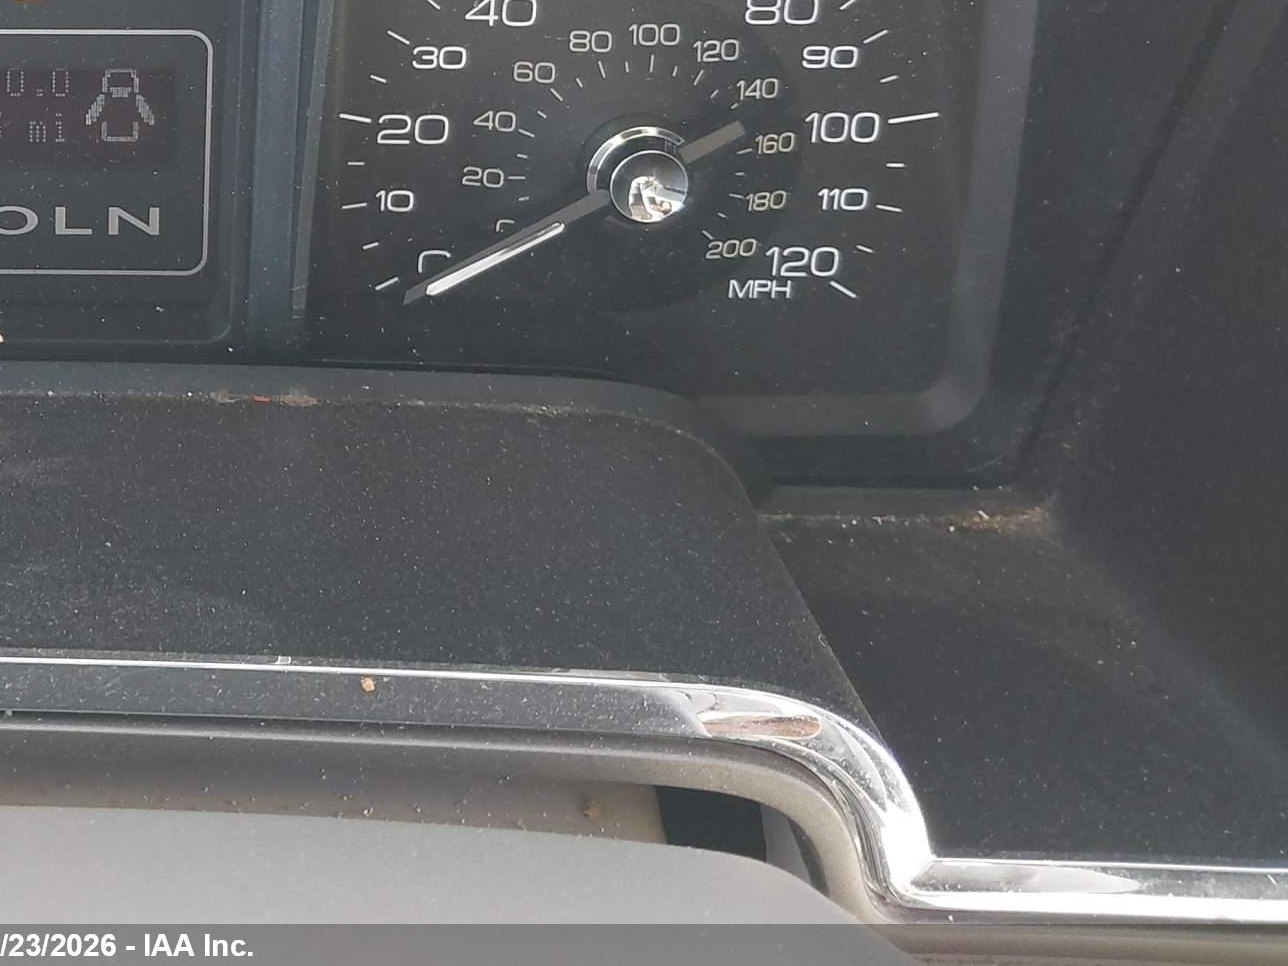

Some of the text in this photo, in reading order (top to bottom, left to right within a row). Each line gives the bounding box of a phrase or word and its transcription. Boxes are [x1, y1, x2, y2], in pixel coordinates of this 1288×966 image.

[569, 30, 613, 53] 80
[628, 24, 681, 46] 100
[412, 46, 467, 70] 30
[693, 38, 739, 62] 120
[802, 45, 858, 69] 90
[6, 68, 70, 97] 0.0
[513, 62, 557, 84] 60
[736, 78, 779, 100] 140
[29, 112, 66, 142] mi
[377, 114, 449, 145] 20
[473, 111, 516, 132] 40
[805, 112, 881, 143] 100
[755, 132, 795, 154] 160
[461, 167, 505, 188] 20
[375, 190, 414, 213] 10
[745, 190, 787, 212] 180
[817, 188, 868, 211] 110
[705, 239, 757, 259] 200
[765, 246, 839, 278] 120
[728, 280, 793, 299] MPH
